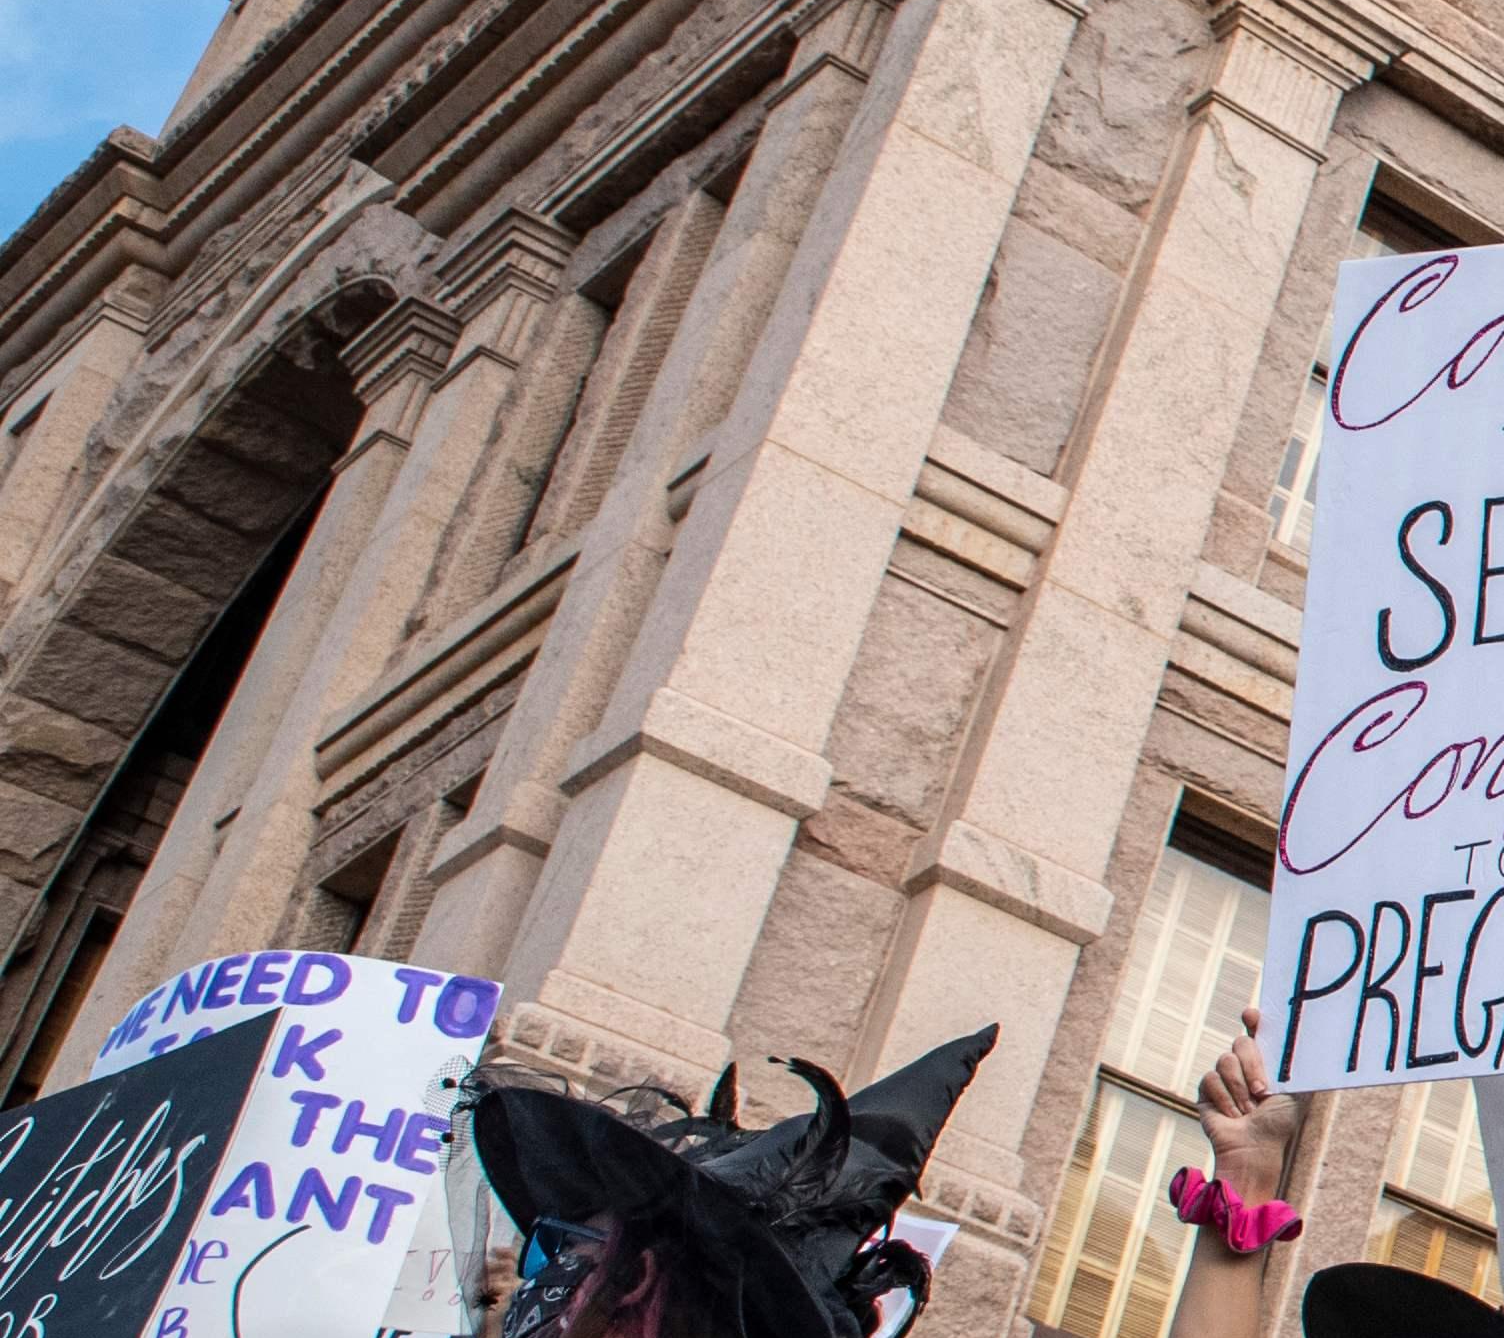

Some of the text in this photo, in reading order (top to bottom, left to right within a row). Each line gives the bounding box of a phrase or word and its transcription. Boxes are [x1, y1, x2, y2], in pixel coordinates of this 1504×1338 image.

[162, 951, 352, 1024] NEED
[395, 967, 500, 1039] TO
[290, 1089, 452, 1175] THE
[211, 1161, 414, 1245] ANT
